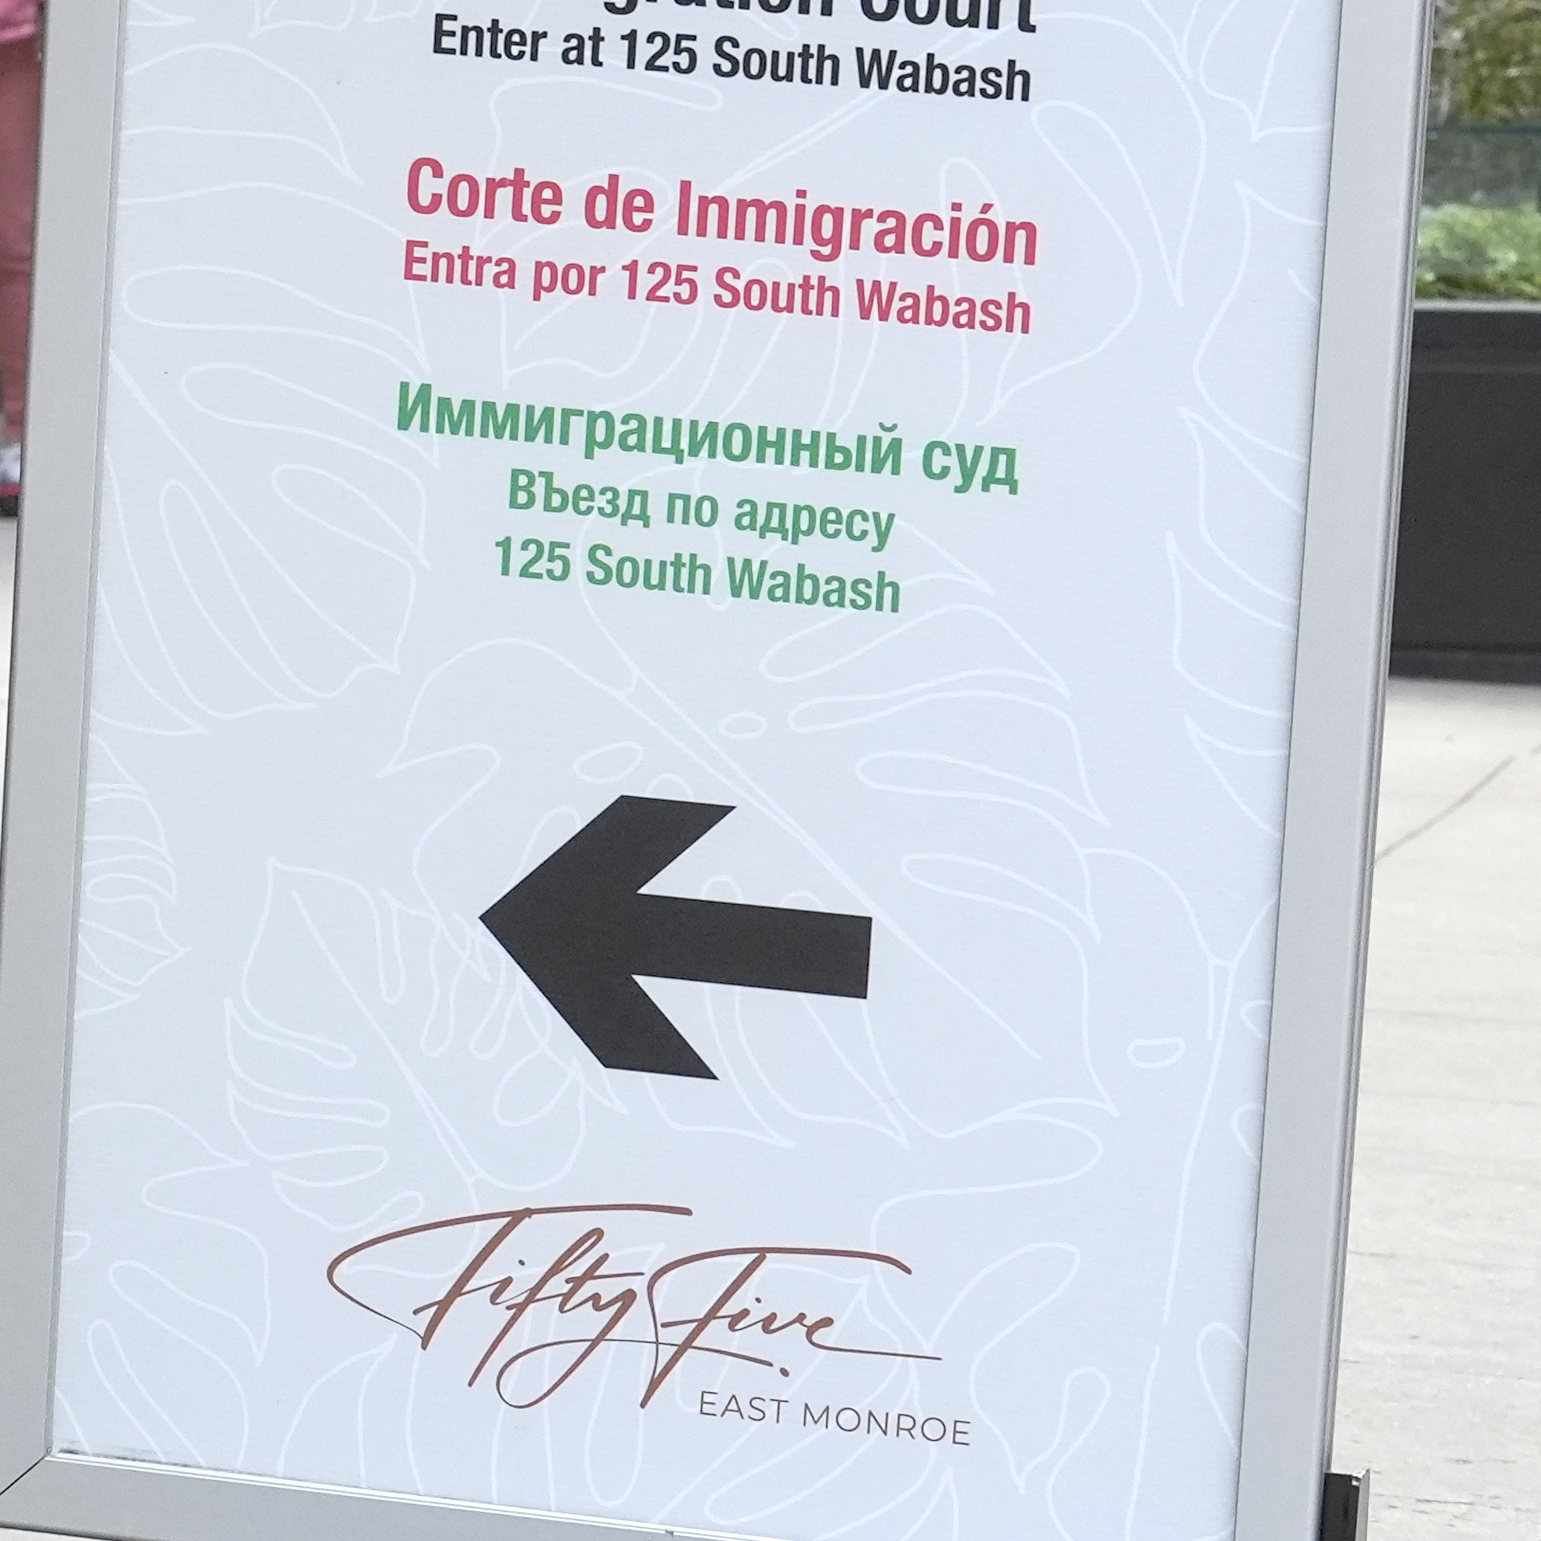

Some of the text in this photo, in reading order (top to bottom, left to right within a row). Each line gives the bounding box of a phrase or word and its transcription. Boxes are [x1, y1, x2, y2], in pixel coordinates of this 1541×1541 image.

[433, 13, 1030, 102] Enter at 125 South Wabash
[408, 158, 1037, 265] Corte de Inmigración
[404, 240, 1030, 334] Entra por 125 South Wabash
[398, 382, 1018, 495] Иммиграционный суд
[667, 493, 718, 527] по
[735, 499, 895, 552] адресу
[496, 537, 899, 613] 125 South Wabash
[327, 1204, 942, 1408] Fifty Five
[700, 1391, 970, 1445] EAST MONROE
